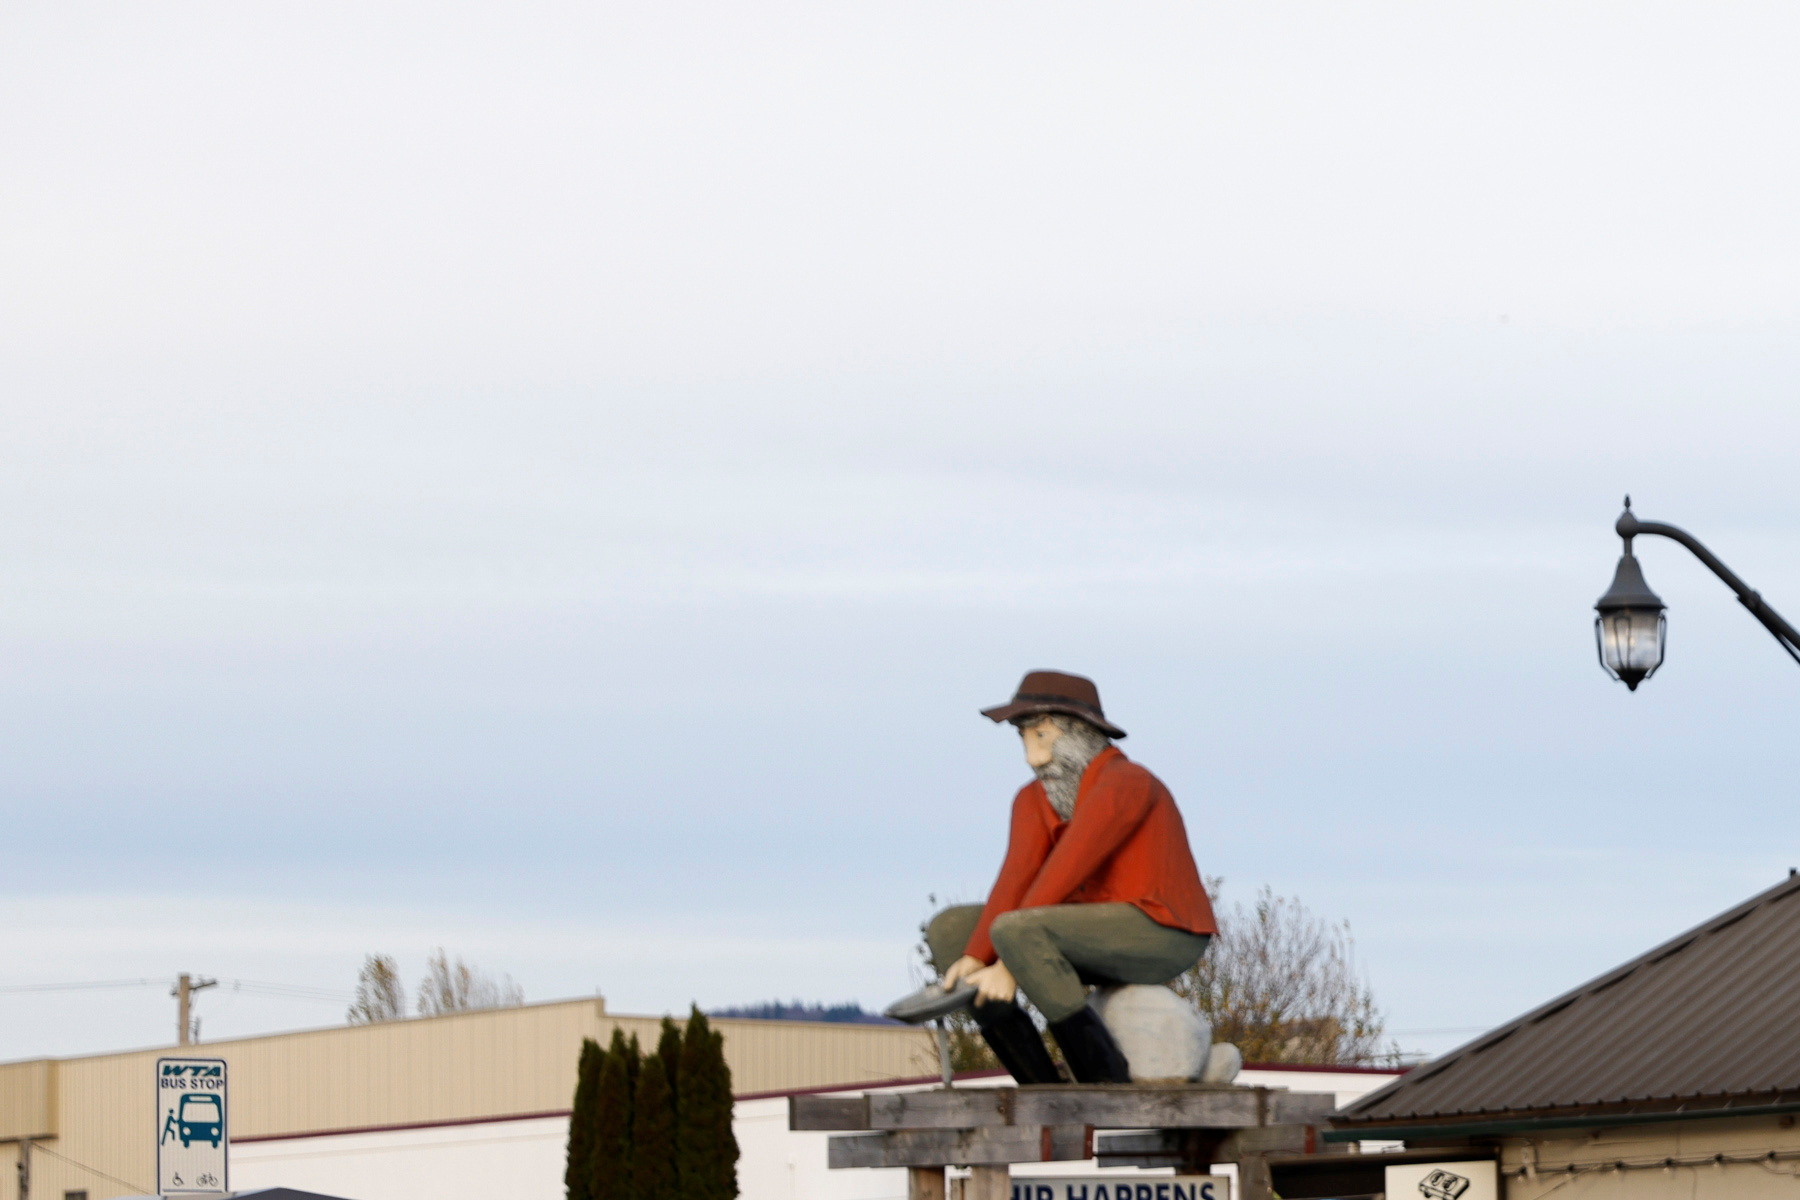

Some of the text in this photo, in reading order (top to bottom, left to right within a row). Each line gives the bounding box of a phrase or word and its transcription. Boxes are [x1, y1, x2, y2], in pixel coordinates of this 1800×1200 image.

[163, 1065, 221, 1077] WTA
[161, 1078, 225, 1090] BUS STOP
